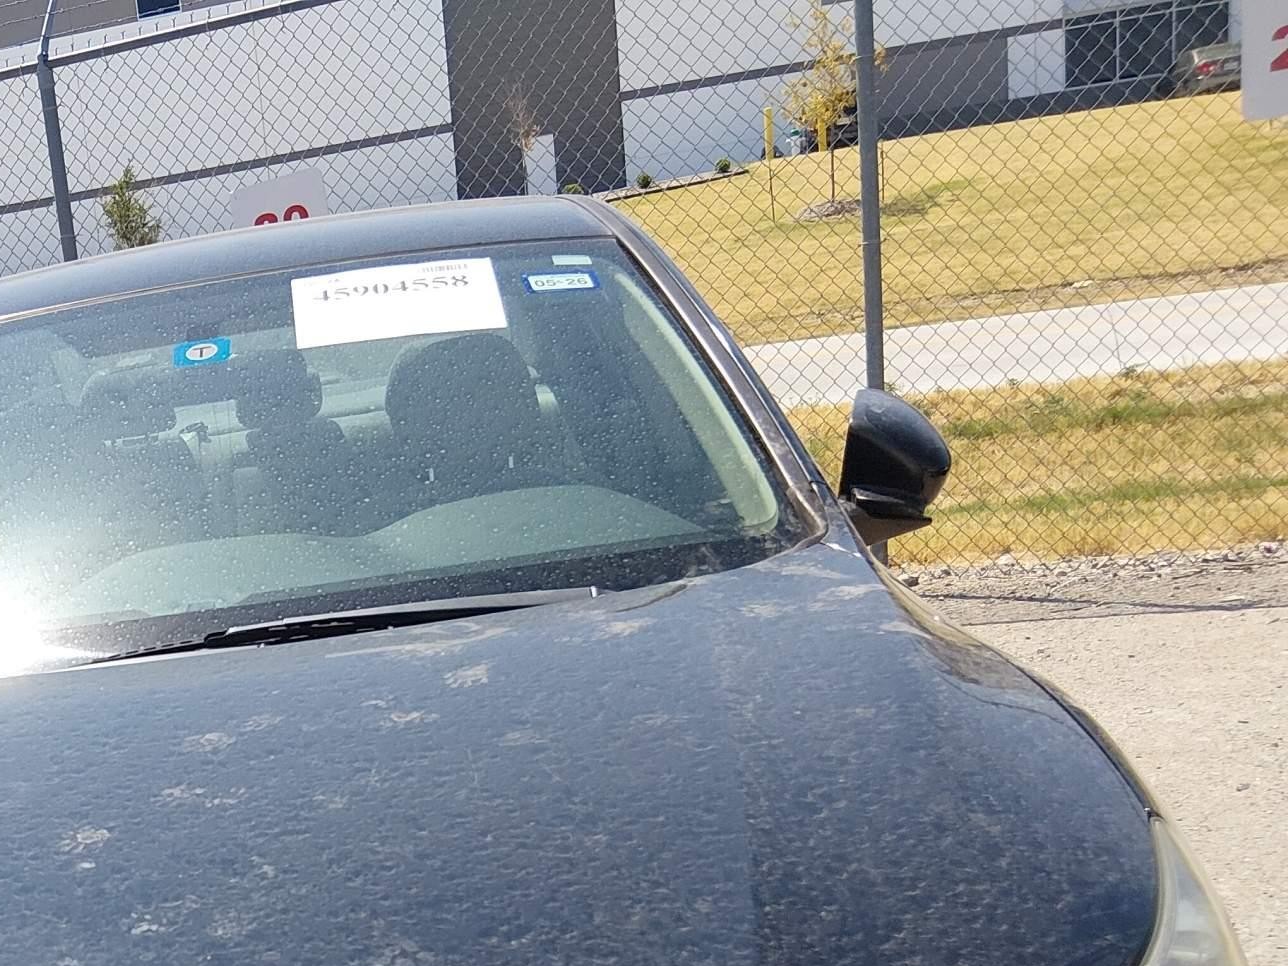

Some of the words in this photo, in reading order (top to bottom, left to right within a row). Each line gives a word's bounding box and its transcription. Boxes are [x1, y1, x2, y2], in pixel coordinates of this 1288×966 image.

[314, 274, 469, 302] 45904558
[534, 277, 588, 287] 05-26
[192, 345, 212, 358] T
